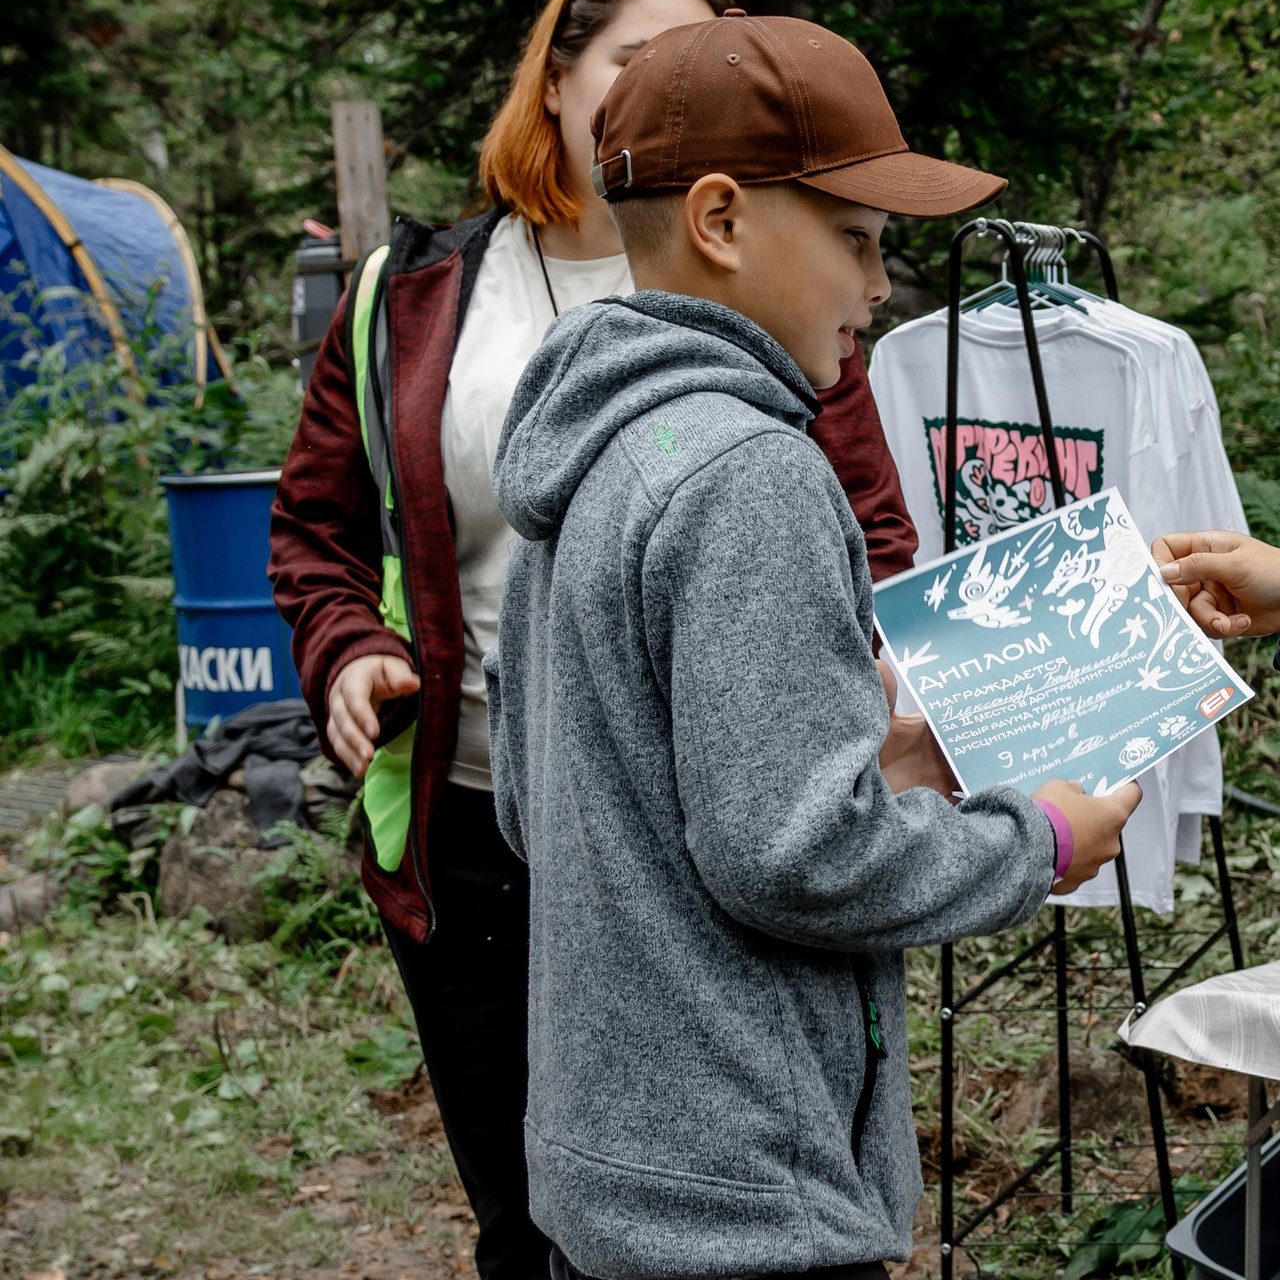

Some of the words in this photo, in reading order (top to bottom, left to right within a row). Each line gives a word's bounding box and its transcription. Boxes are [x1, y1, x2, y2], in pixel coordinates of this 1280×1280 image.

[918, 631, 1053, 695] ДИПЛОМ
[928, 655, 1069, 710] НАГРАЖДАЕТСЯ
[973, 703, 1018, 723] МЕСТО
[990, 711, 1034, 731] РАУНД
[1108, 710, 1160, 742] ВИКТОРИЯ
[1159, 675, 1223, 714] ПРОКОПЬЕВА
[954, 720, 1041, 757] ДИСЦИПЛИНА
[998, 751, 1014, 769] 9
